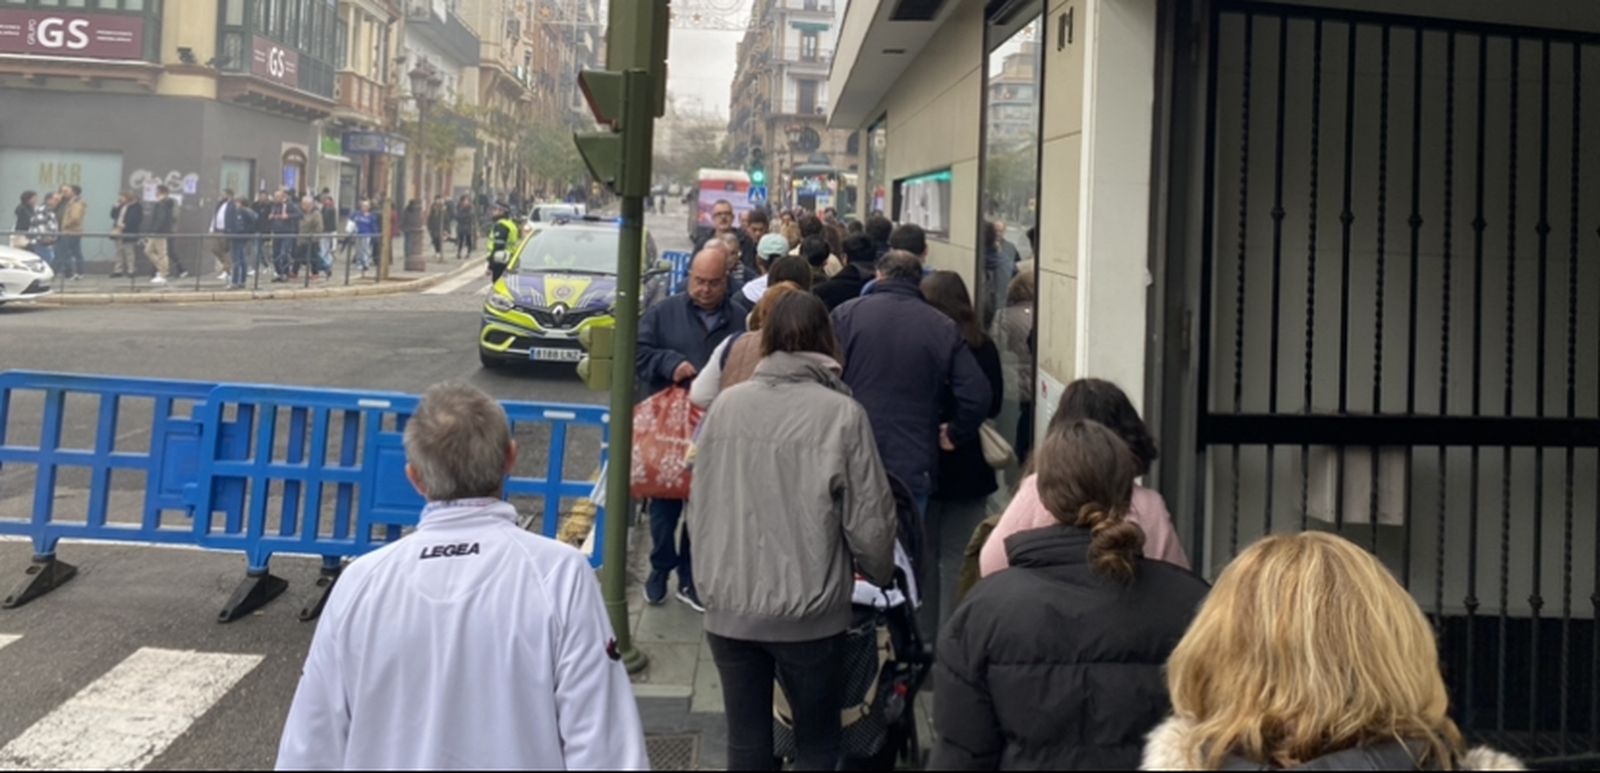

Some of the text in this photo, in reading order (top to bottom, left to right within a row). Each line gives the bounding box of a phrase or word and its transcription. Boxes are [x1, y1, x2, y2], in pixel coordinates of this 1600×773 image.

[27, 17, 90, 49] GRUPO GS
[268, 46, 285, 78] GS
[419, 541, 480, 560] LEGEA
